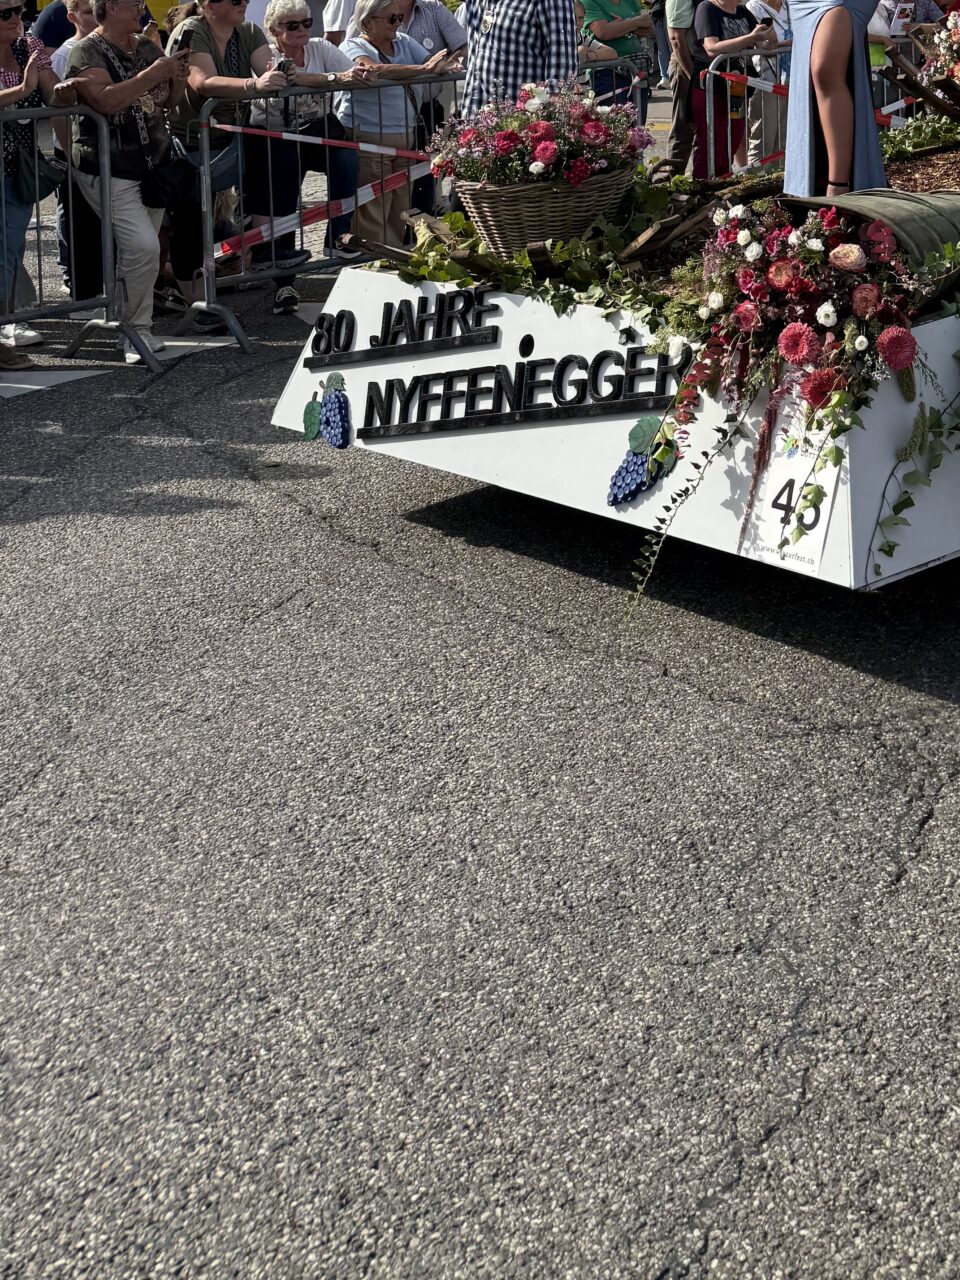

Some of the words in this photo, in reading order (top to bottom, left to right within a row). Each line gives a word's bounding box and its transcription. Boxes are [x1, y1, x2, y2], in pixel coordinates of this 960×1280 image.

[311, 309, 355, 357] 80
[370, 286, 499, 349] JAHRE
[364, 342, 692, 428] NYFFENEGGER
